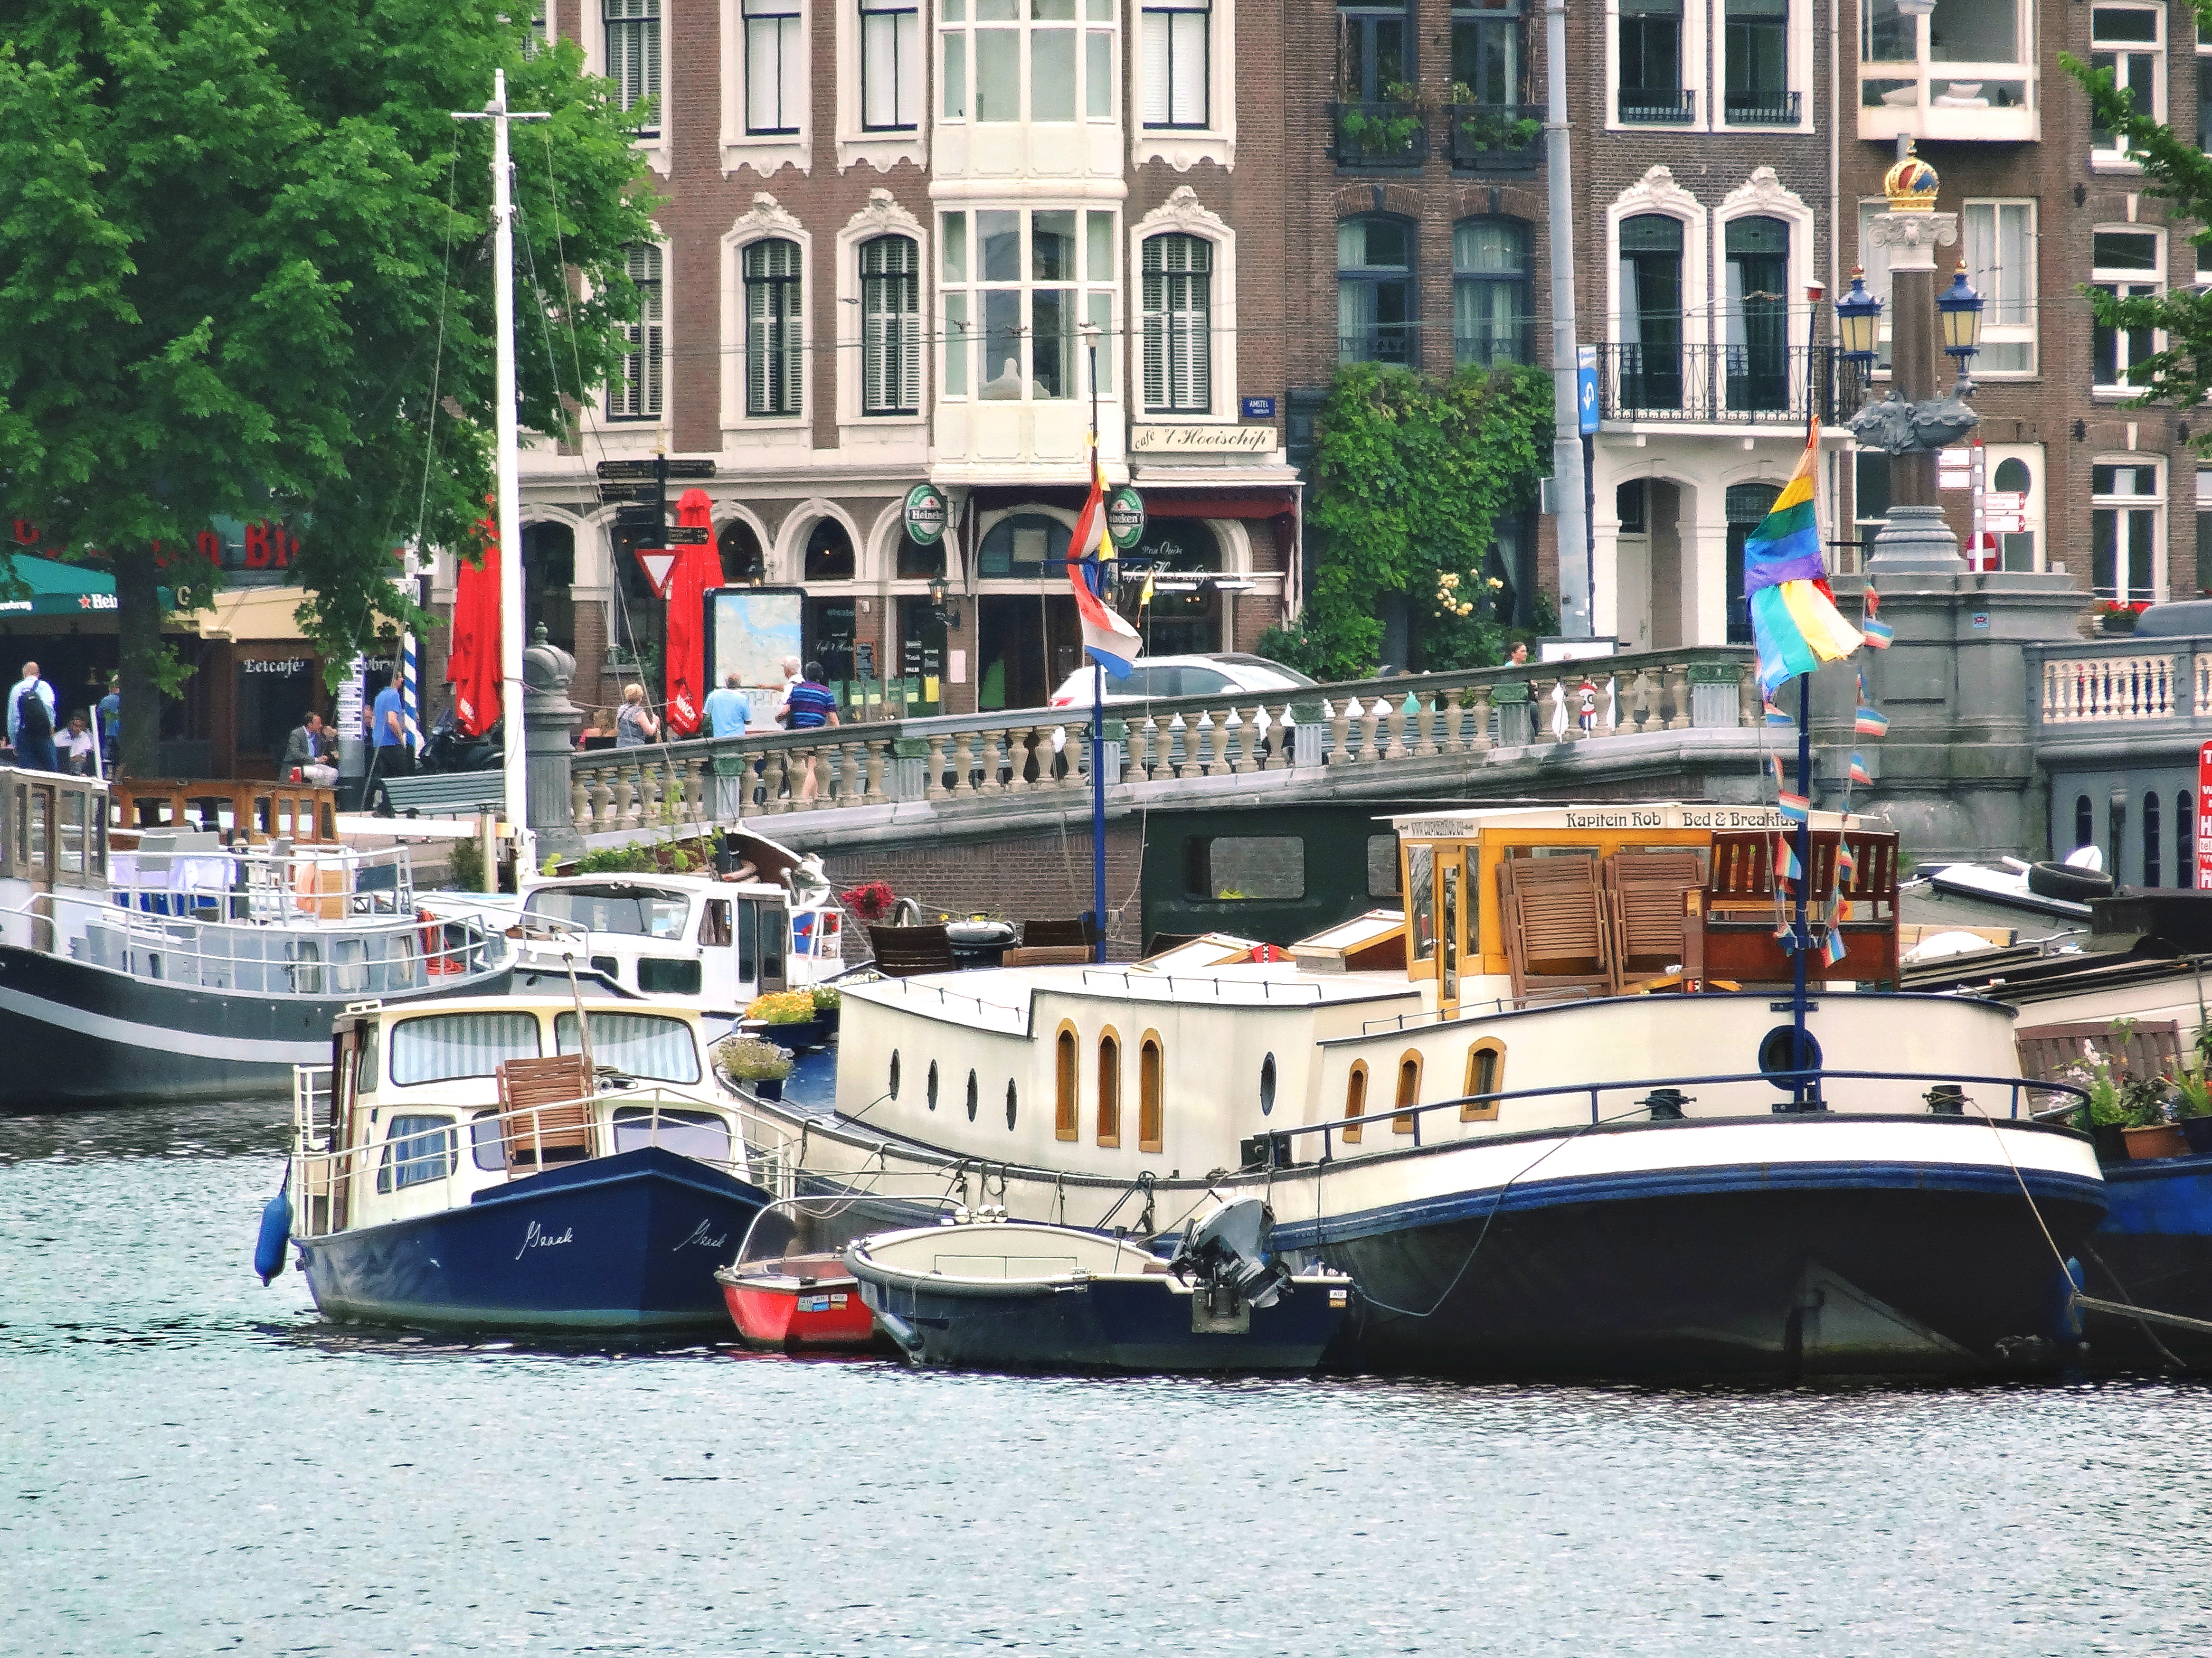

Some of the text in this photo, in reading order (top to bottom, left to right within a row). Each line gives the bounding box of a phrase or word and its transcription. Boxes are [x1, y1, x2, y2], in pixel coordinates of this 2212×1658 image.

[1249, 400, 1268, 408] AMSTEL
[1134, 428, 1155, 449] café
[1566, 812, 1627, 828] Kapitein
[1631, 811, 1661, 826] Rob
[1683, 812, 1711, 827] Bed
[1715, 812, 1726, 826] &
